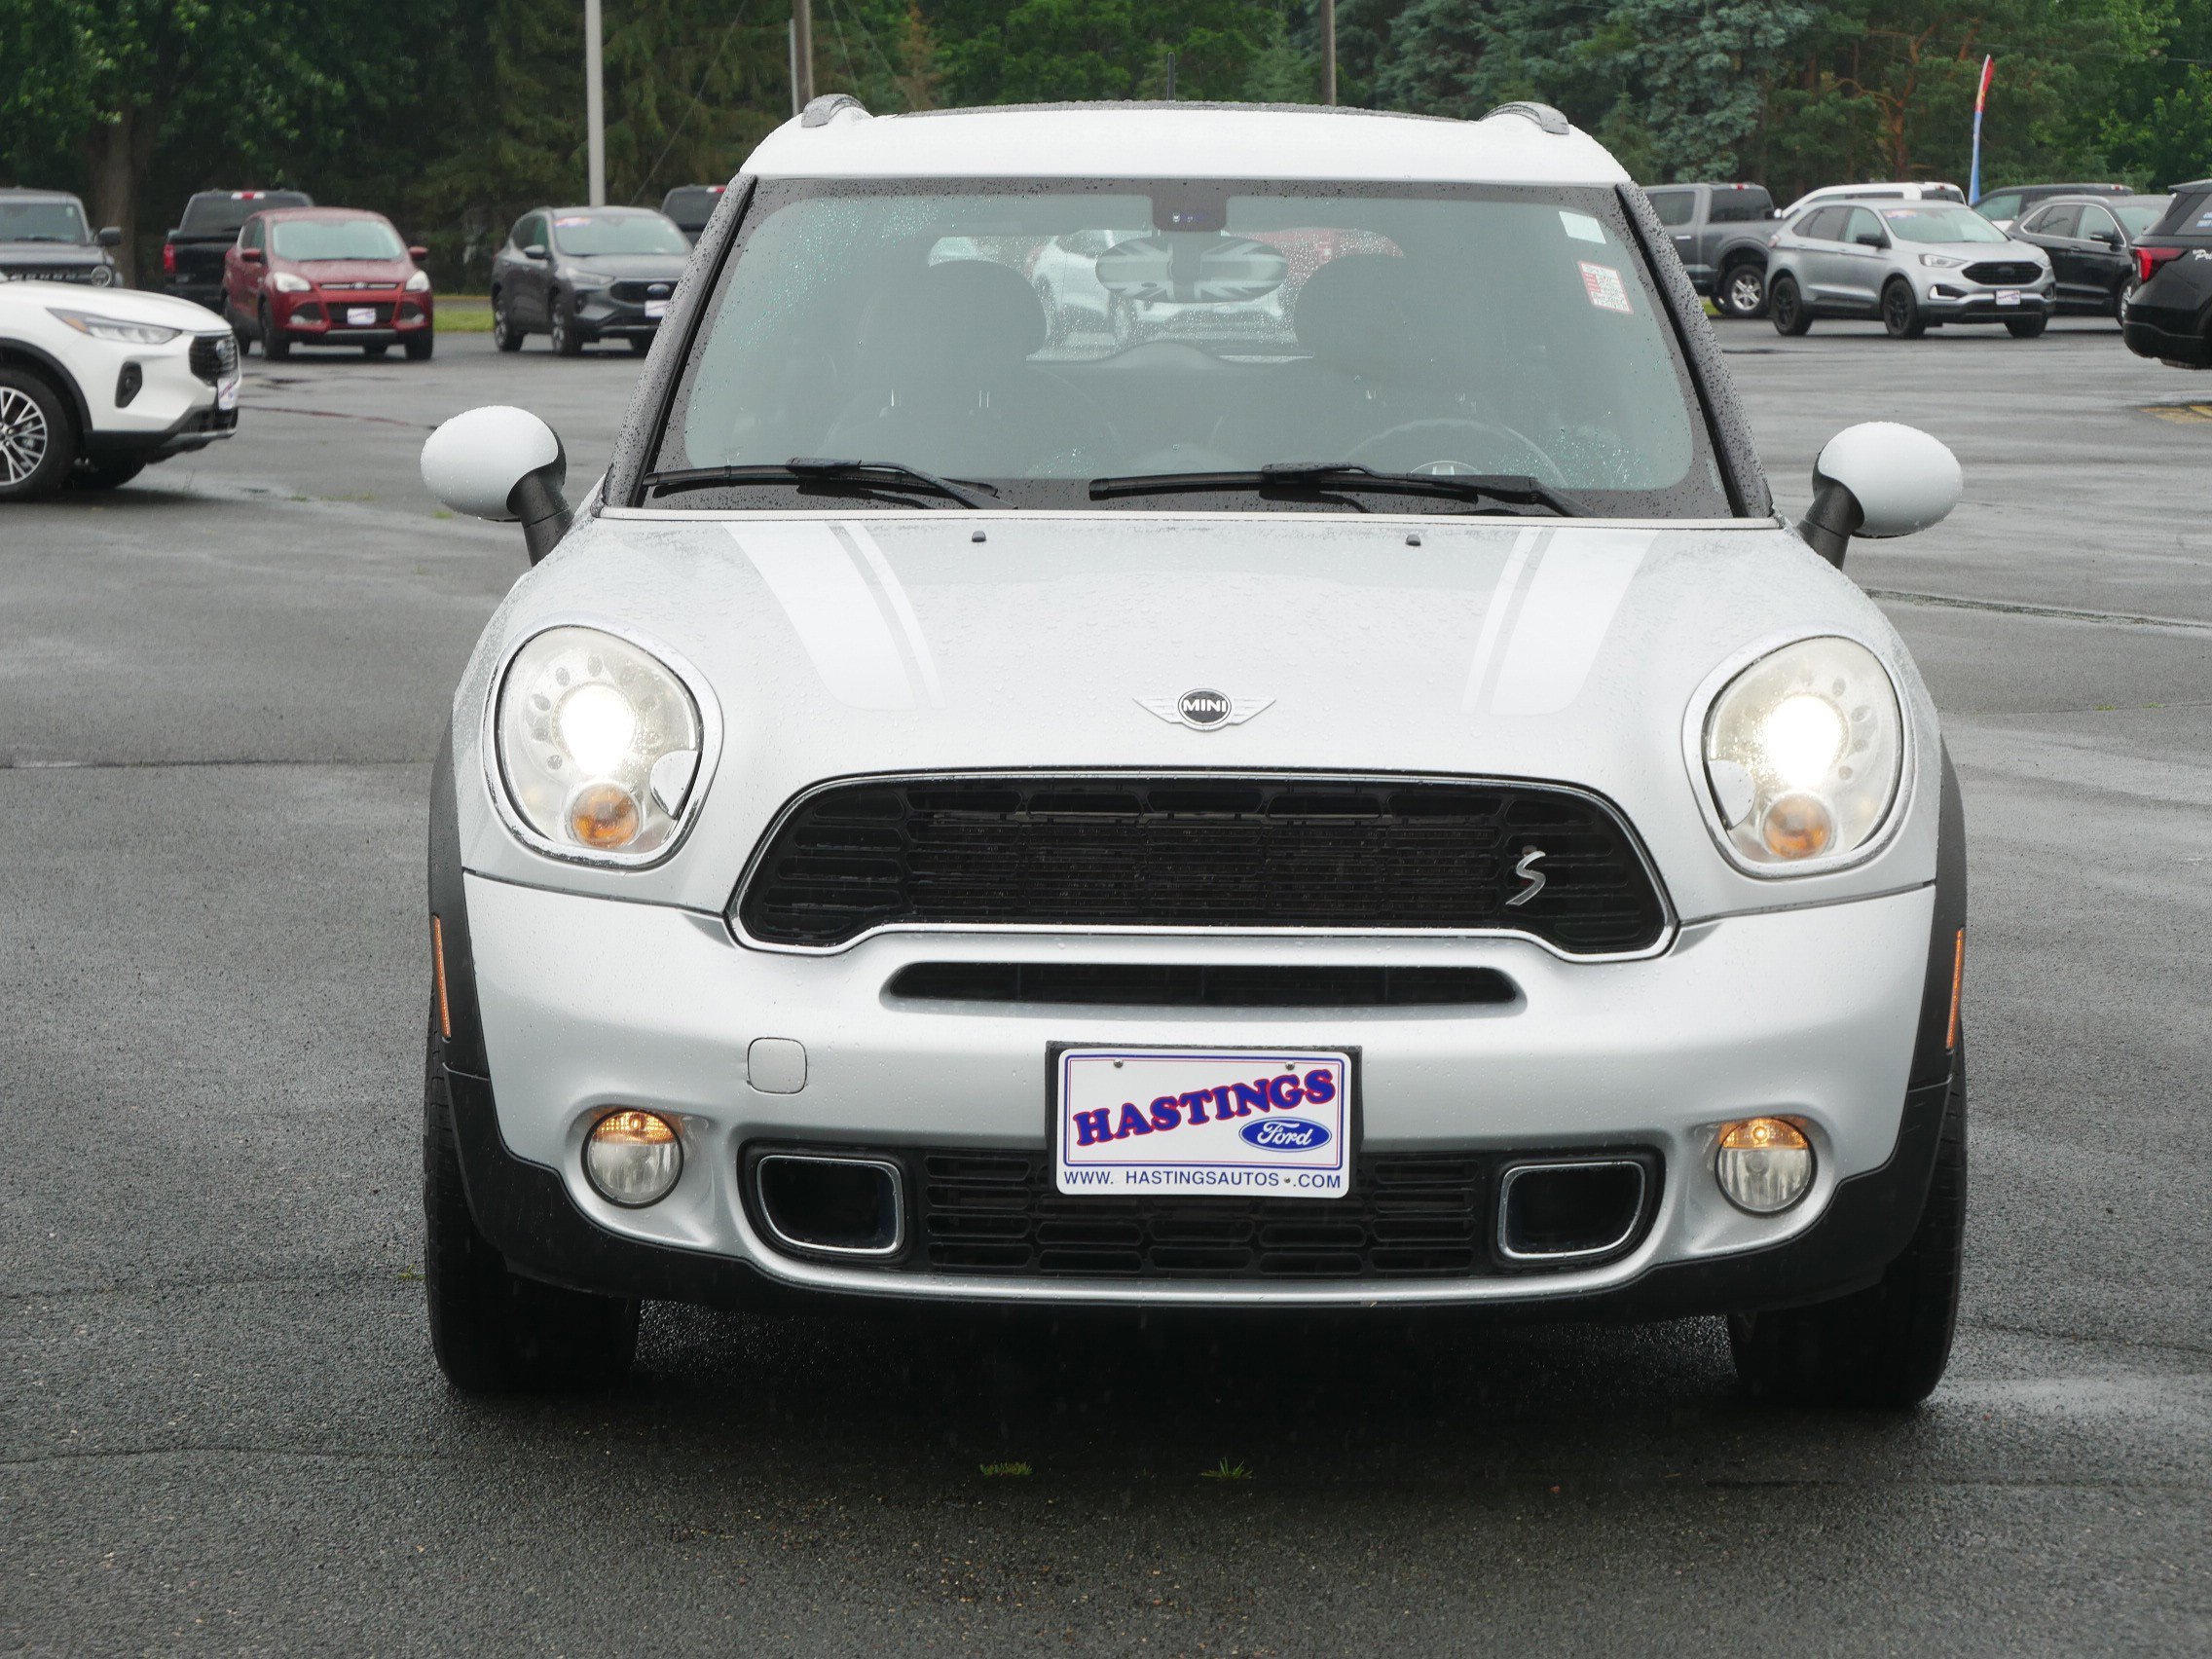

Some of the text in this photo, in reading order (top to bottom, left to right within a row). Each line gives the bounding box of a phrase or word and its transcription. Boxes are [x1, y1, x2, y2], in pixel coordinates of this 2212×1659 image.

[1183, 699, 1227, 713] MINI
[1505, 850, 1546, 906] S
[1073, 1069, 1336, 1147] HASTINGS
[1257, 1121, 1313, 1146] Ford
